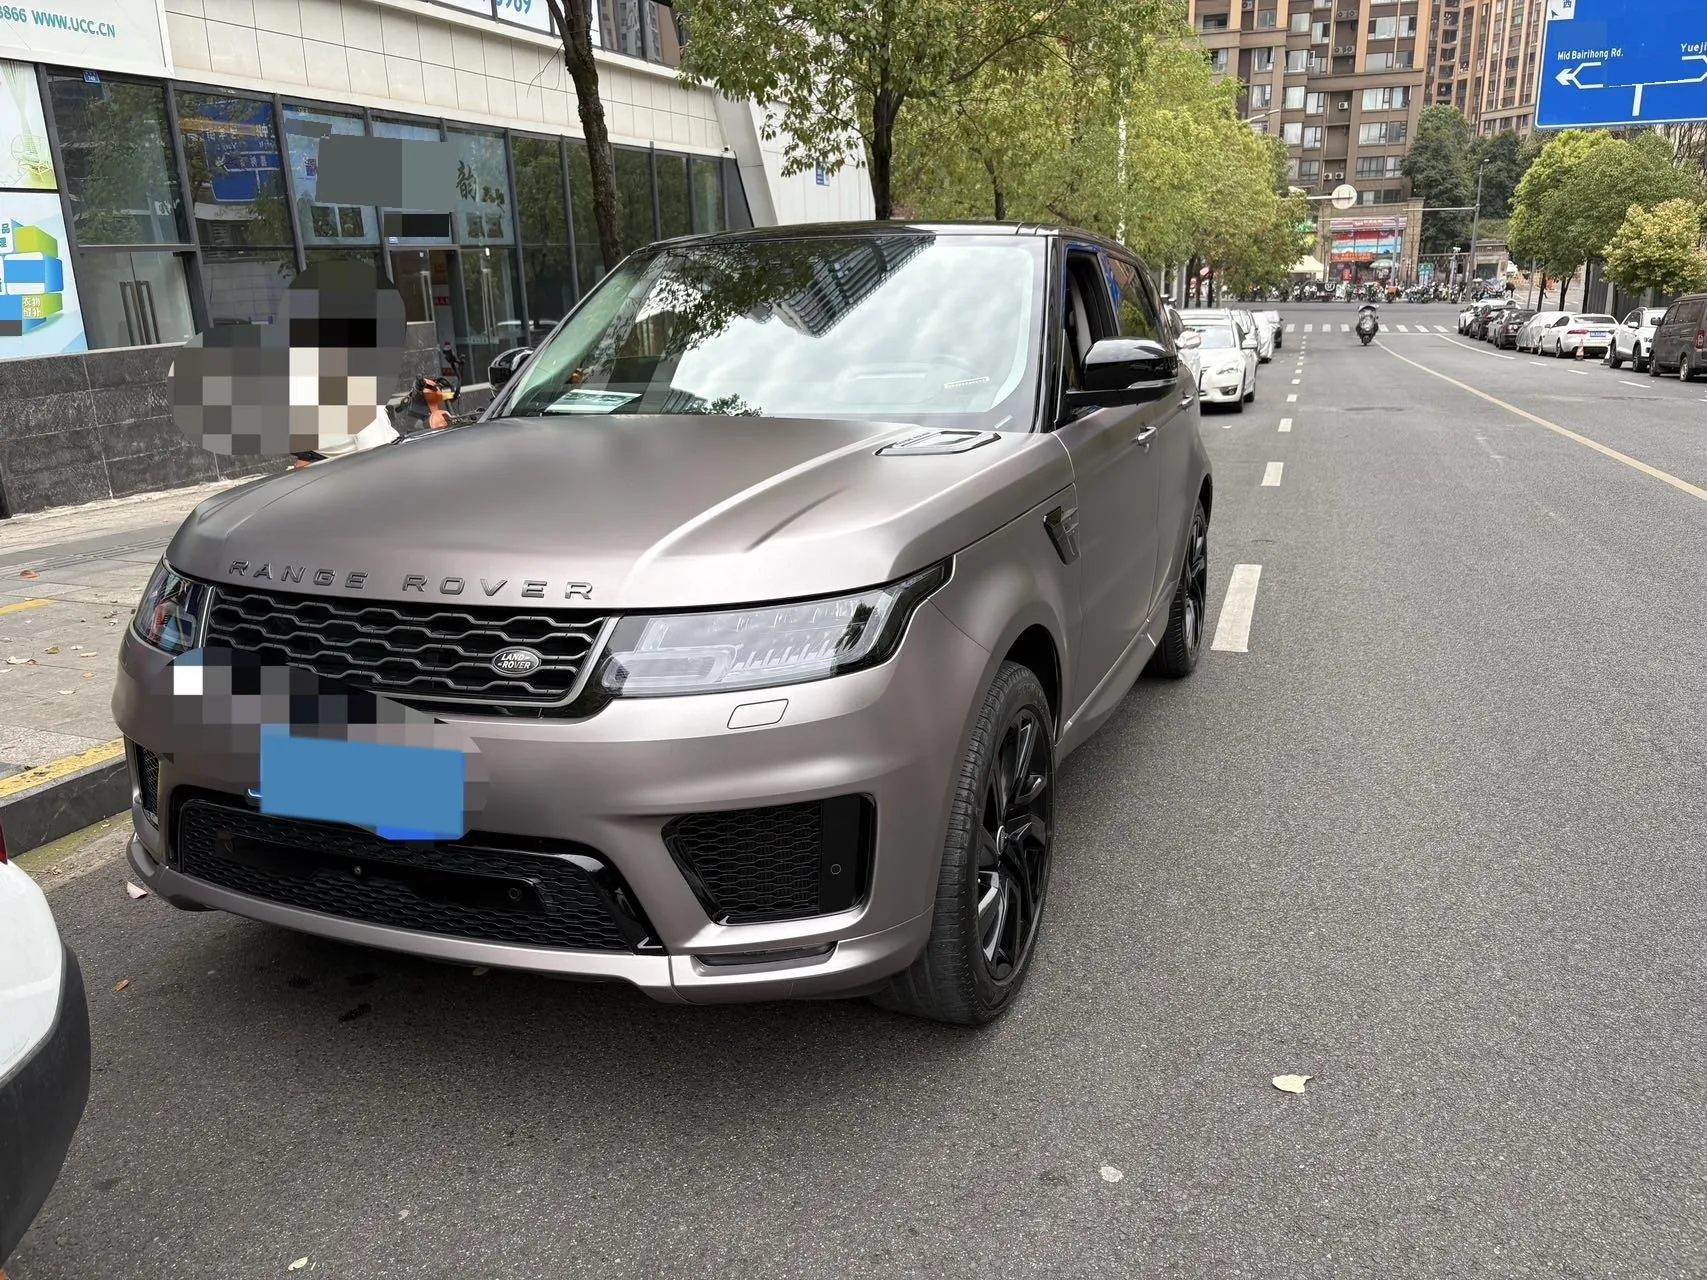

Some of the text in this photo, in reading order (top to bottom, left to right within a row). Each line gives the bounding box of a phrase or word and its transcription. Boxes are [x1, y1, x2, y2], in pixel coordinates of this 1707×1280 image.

[31, 10, 116, 38] WWW.UCC.CN
[1557, 48, 1624, 61] Mid Bairihong Rd.
[228, 560, 594, 600] RANGE ROVER
[501, 653, 525, 661] LAND
[502, 660, 531, 669] ROVER
